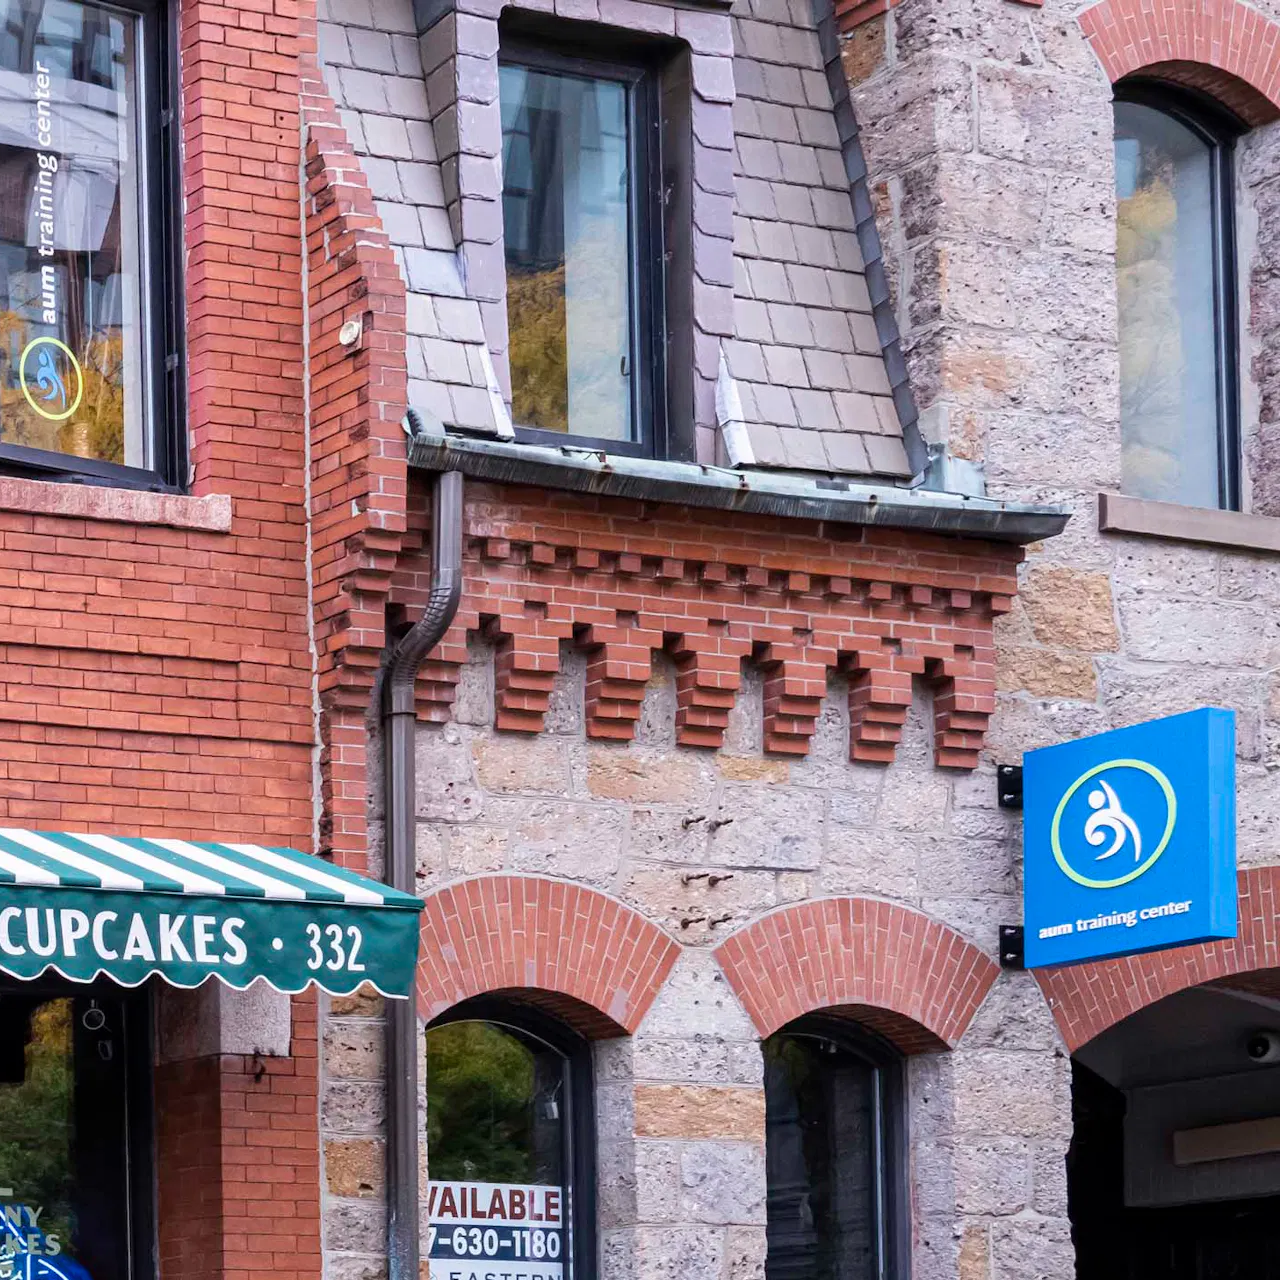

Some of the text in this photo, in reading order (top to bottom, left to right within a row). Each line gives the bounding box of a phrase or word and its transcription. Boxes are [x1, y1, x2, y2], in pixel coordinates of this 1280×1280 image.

[34, 61, 58, 324] aum training center
[1039, 900, 1193, 939] aum training center
[304, 922, 366, 973] 332
